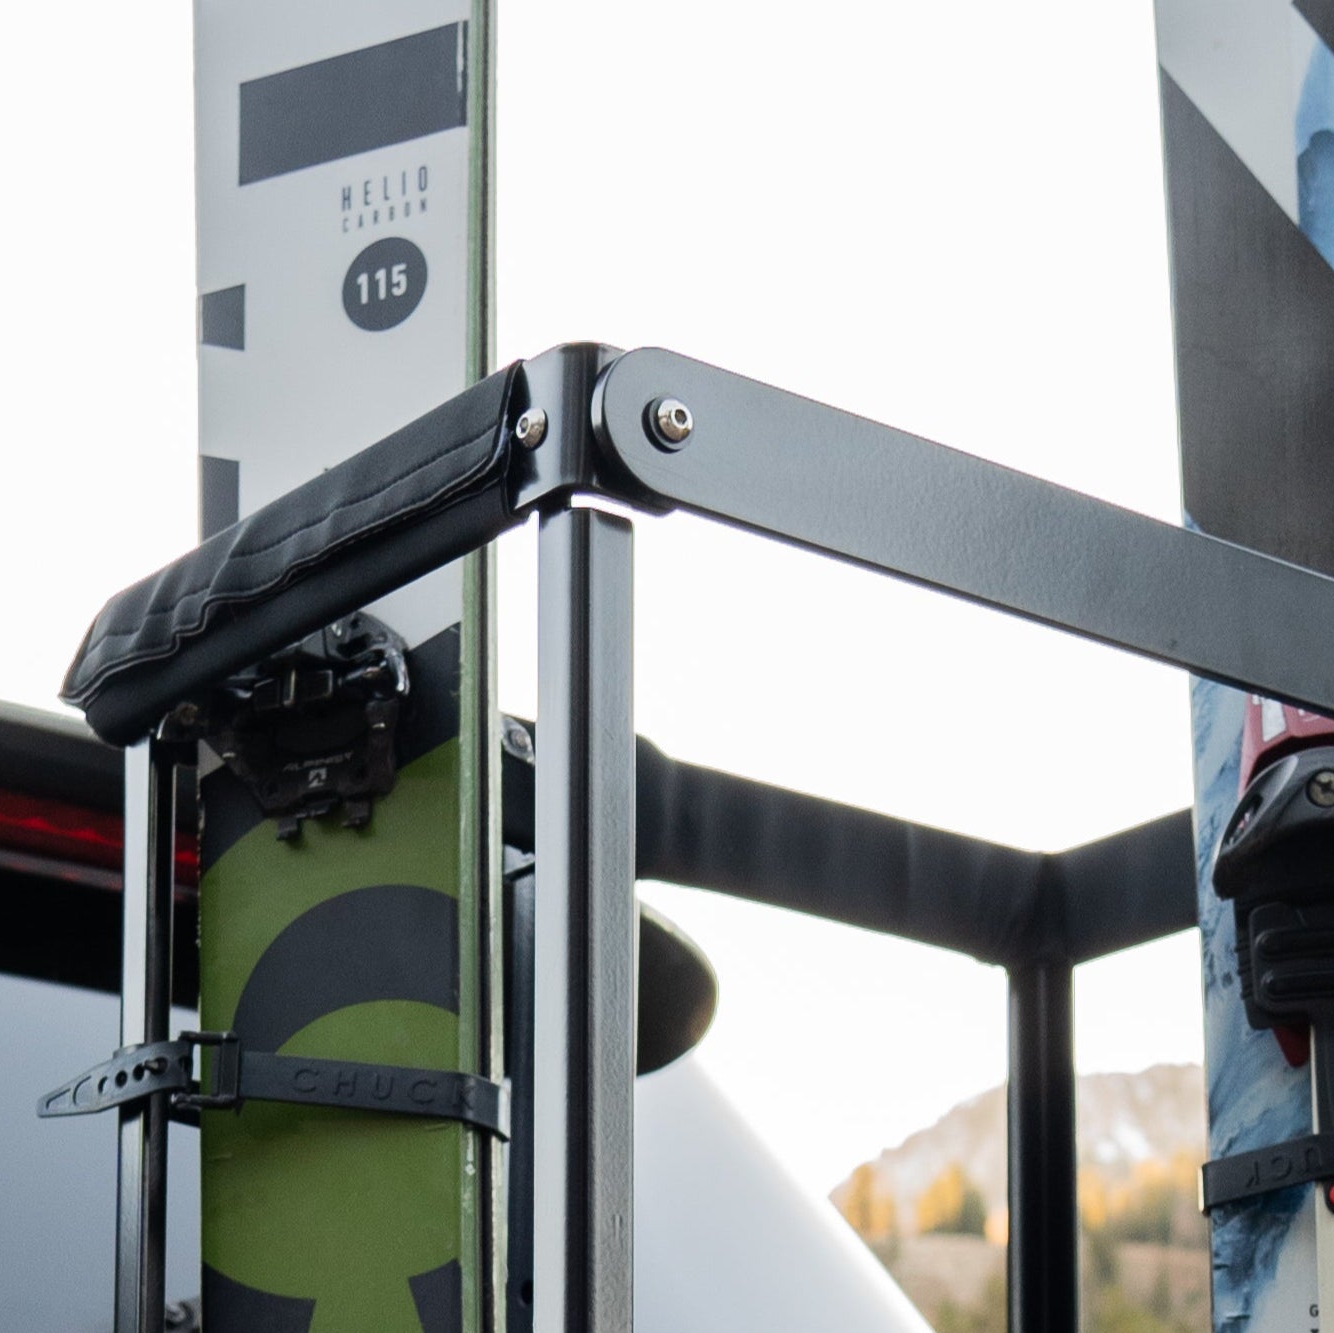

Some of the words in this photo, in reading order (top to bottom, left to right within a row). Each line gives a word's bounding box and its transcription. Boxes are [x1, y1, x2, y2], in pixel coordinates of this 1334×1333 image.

[341, 166, 428, 211] HELIO
[341, 198, 428, 234] CARBON
[356, 263, 408, 305] 115
[292, 1067, 475, 1112] CHUCK
